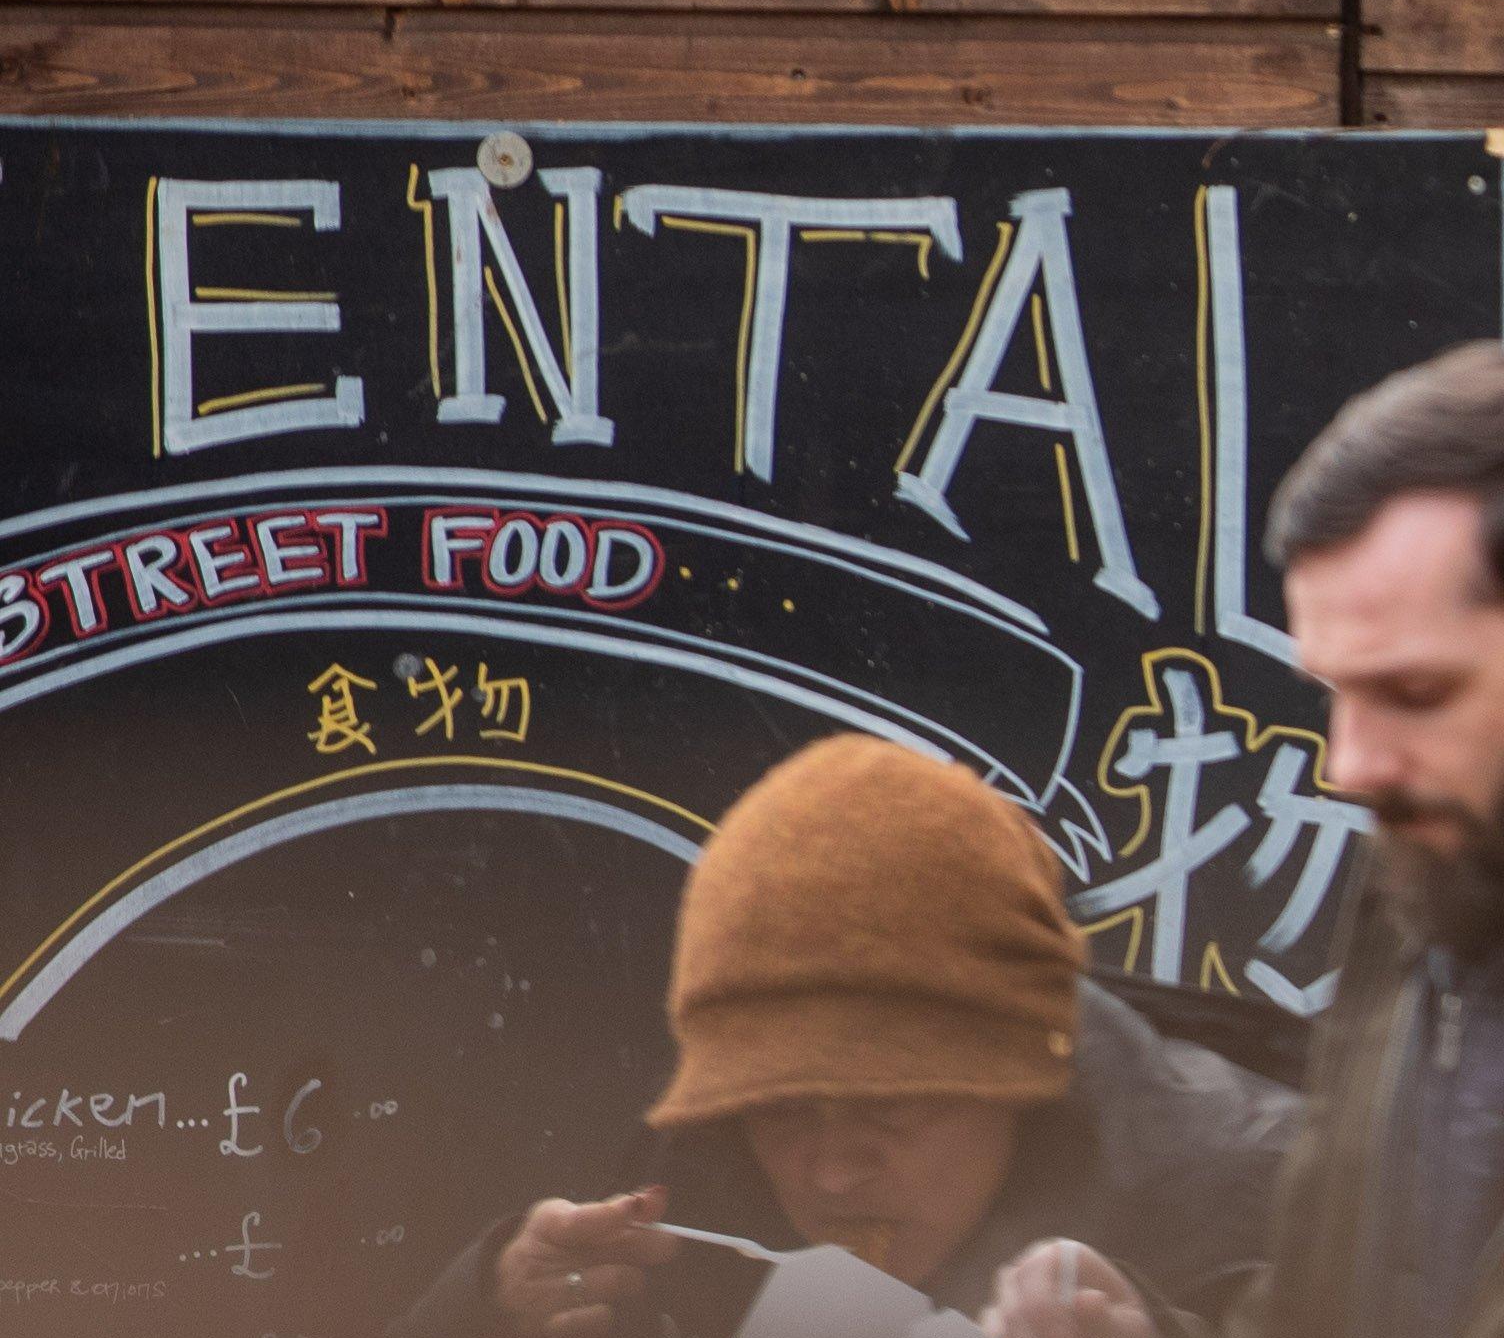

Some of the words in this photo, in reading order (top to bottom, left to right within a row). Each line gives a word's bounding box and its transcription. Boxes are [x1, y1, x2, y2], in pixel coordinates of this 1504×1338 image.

[0, 507, 388, 663] STREET
[422, 508, 665, 610] FOOD
[307, 657, 531, 755] 食物
[70, 1134, 126, 1161] Grilled
